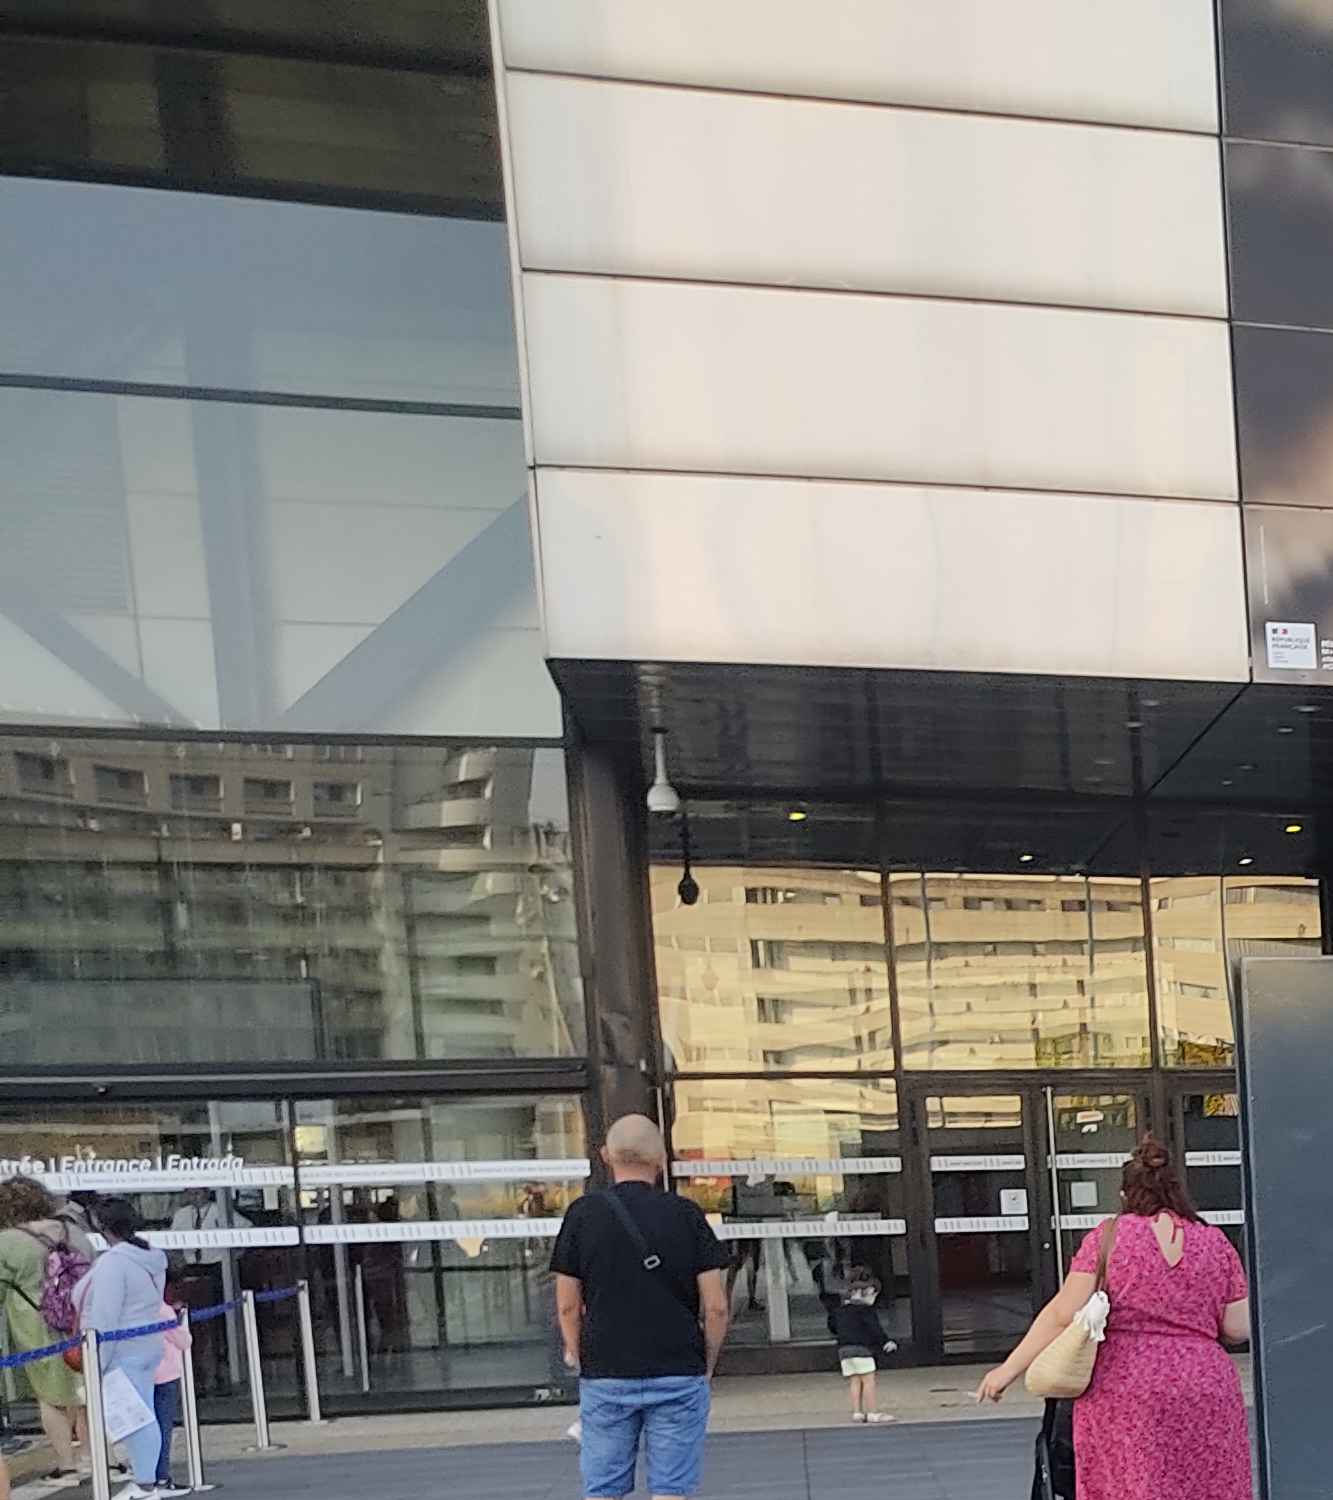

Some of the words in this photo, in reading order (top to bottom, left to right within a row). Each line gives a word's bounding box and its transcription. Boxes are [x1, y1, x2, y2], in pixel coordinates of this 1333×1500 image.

[0, 1155, 46, 1175] trée
[61, 1155, 152, 1175] Entrance
[166, 1153, 245, 1171] Entrada
